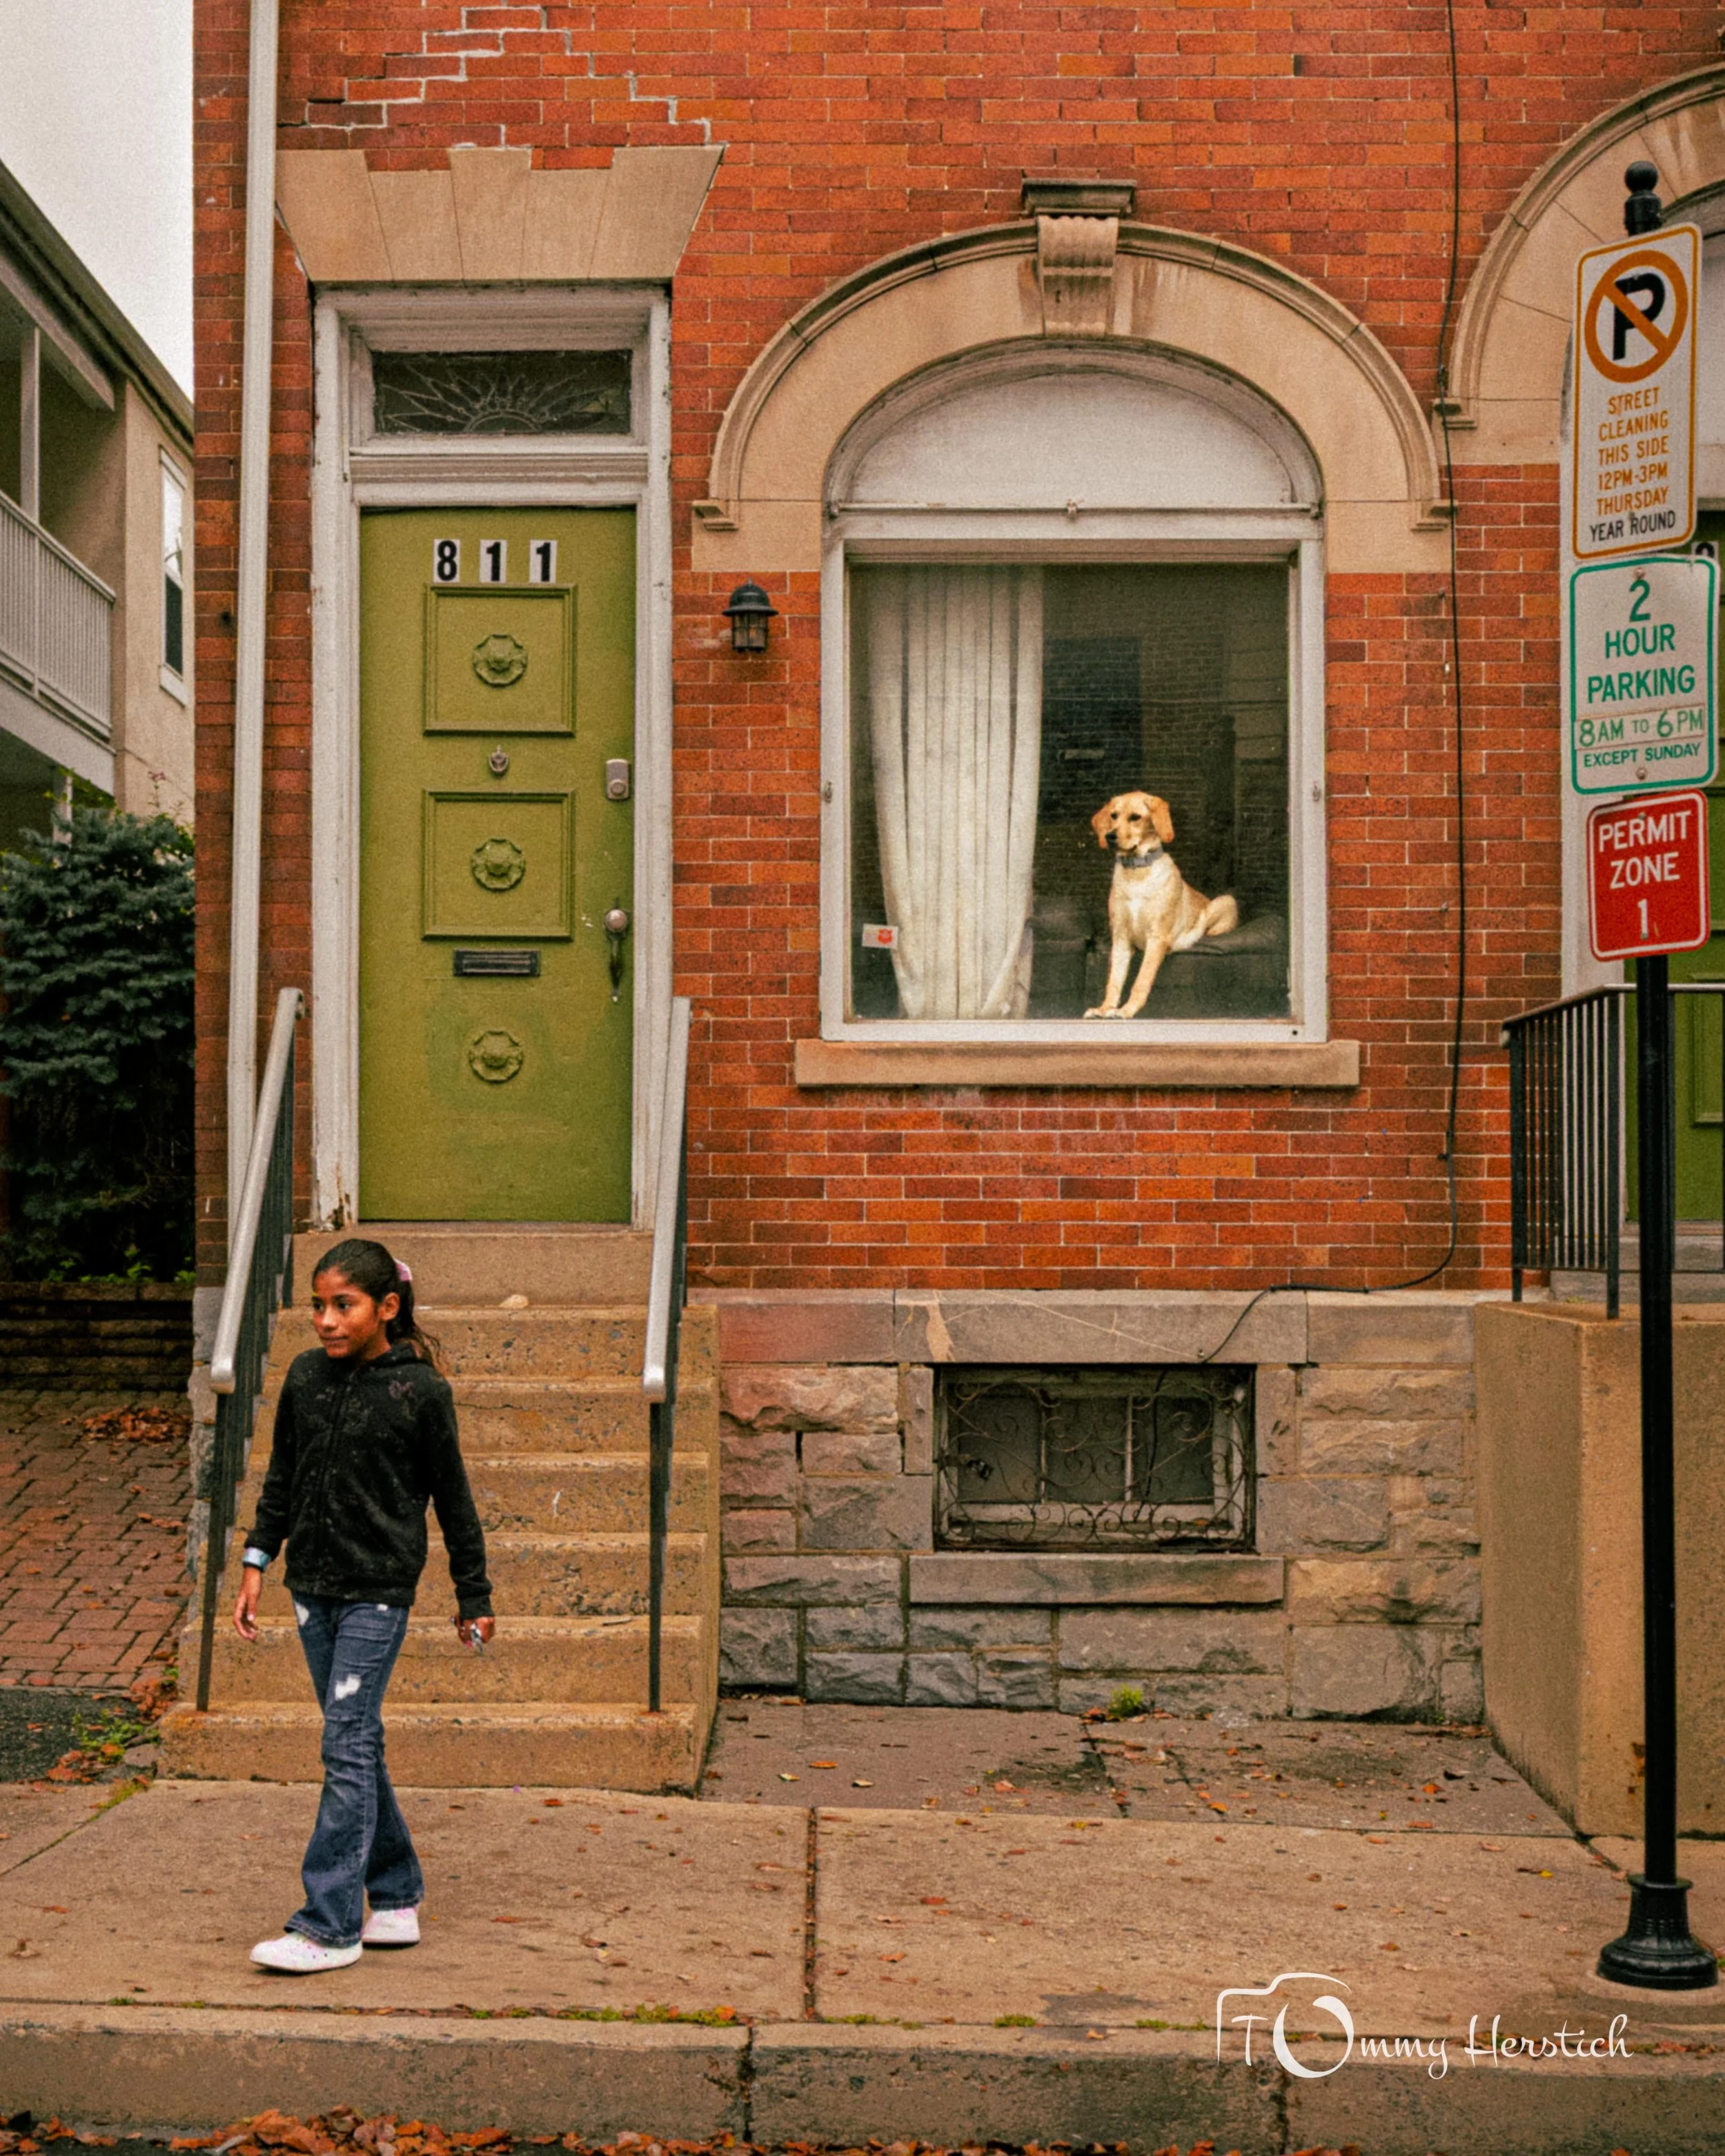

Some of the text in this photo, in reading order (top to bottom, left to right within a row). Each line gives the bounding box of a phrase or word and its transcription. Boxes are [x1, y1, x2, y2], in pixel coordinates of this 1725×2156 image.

[1608, 386, 1659, 415] STREET
[1598, 409, 1668, 442] CLEANING
[1598, 435, 1669, 466] THIS SIDE
[1598, 462, 1668, 491] 12PM-3PM
[1596, 486, 1669, 516] THURSDAY
[1589, 509, 1676, 542] YEAR ROUND
[437, 540, 552, 582] 811
[1629, 579, 1651, 622] 2
[1605, 623, 1676, 659] HOUR
[1588, 664, 1695, 704] PARKING
[1632, 719, 1650, 734] TO
[1584, 742, 1702, 768] EXCEPT SUNDAY
[1599, 810, 1692, 853] PERMIT
[1609, 852, 1681, 889] ZONE
[1637, 898, 1649, 938] 1
